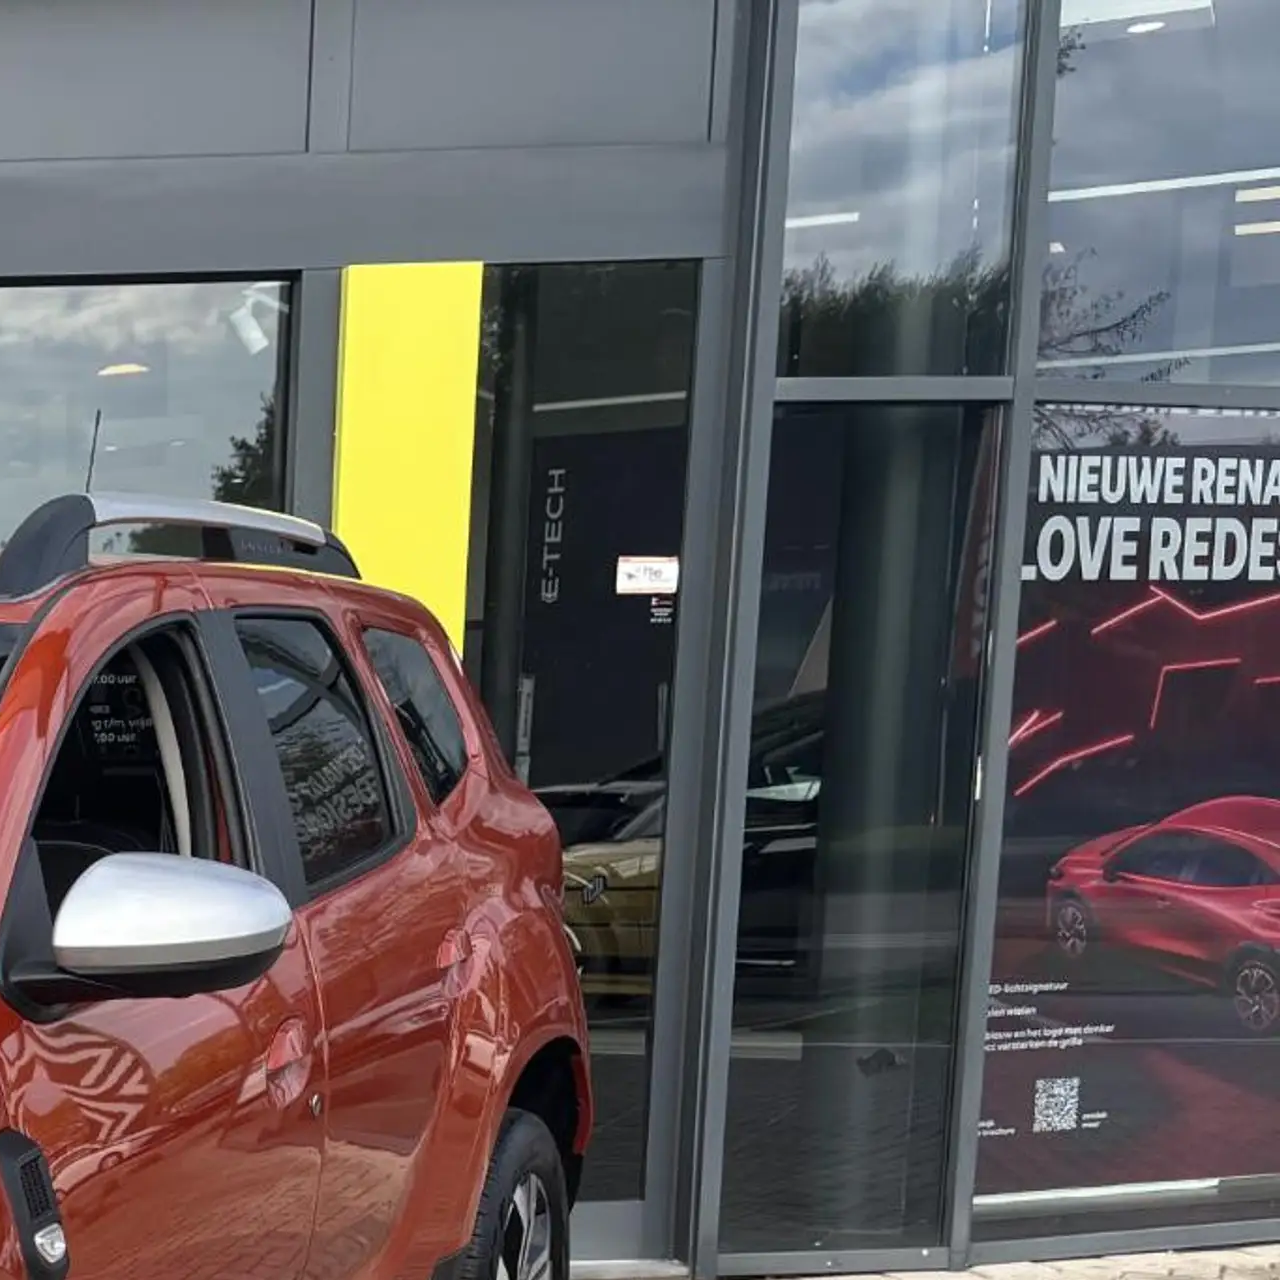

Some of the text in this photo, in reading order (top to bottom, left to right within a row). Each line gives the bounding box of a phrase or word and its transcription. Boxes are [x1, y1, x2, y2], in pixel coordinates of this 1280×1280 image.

[1038, 455, 1185, 504] NIEUWE
[542, 468, 566, 604] E-TECH
[1021, 515, 1280, 582] OVE REDE
